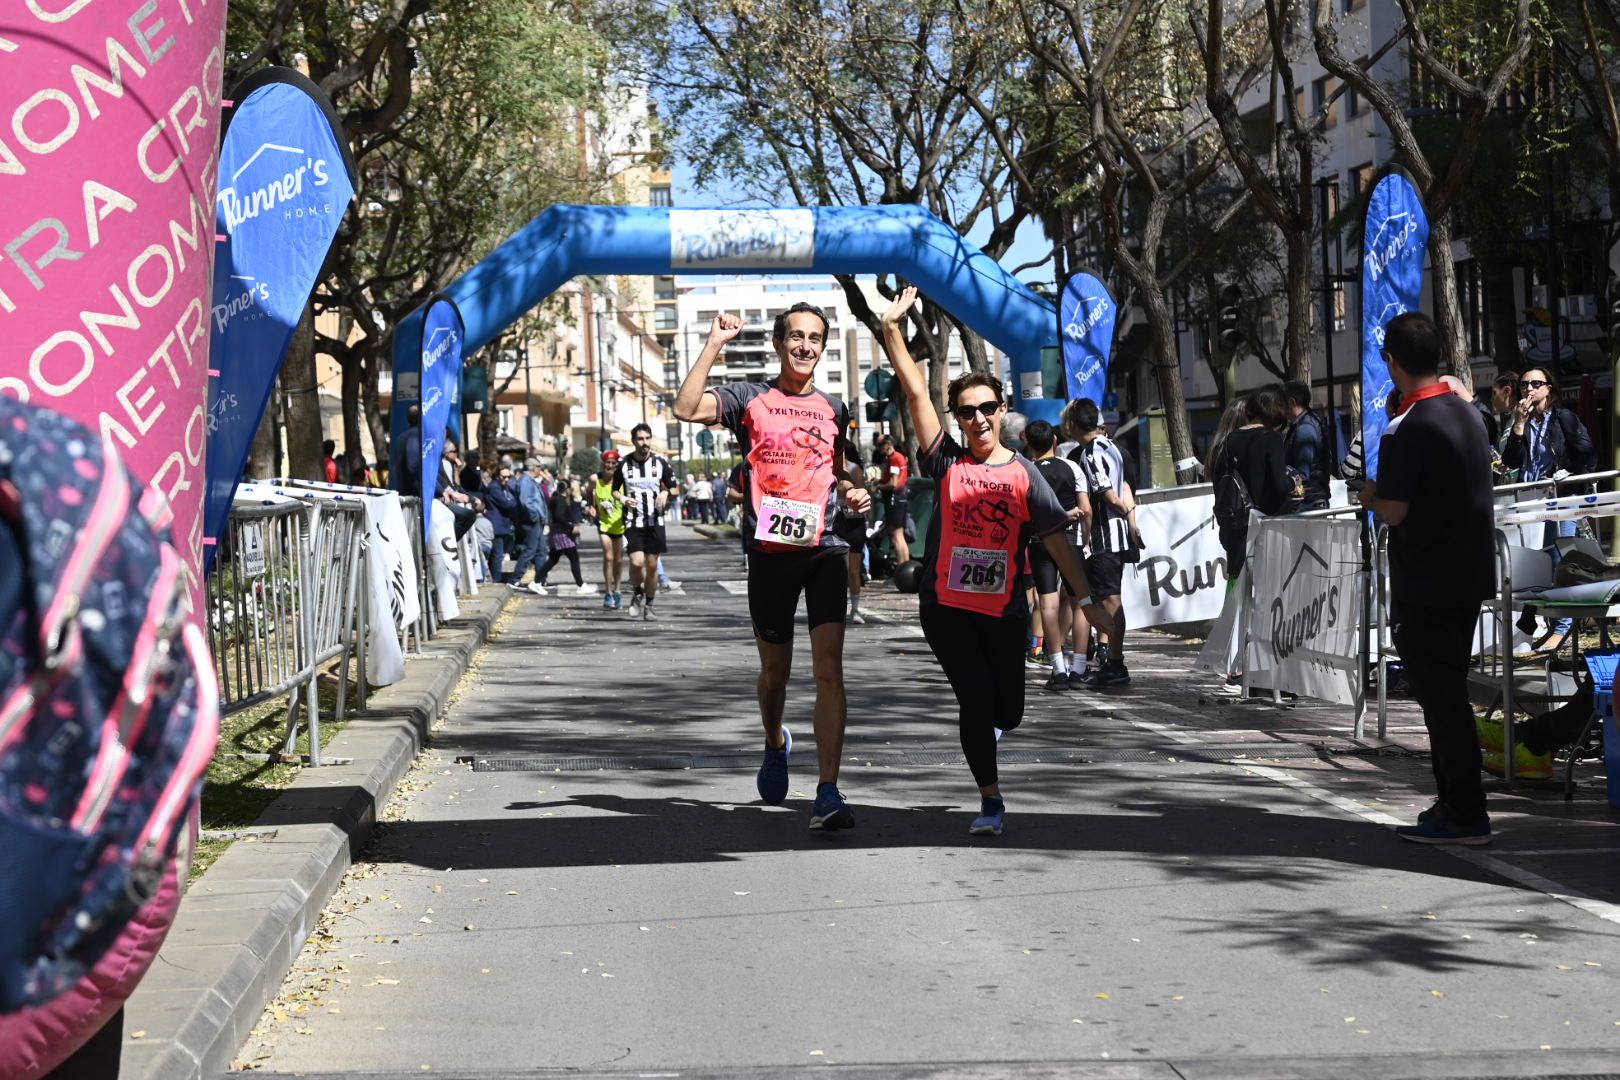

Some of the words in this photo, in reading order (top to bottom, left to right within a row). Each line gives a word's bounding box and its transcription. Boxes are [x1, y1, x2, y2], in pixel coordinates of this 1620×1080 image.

[217, 157, 330, 235] Runner's
[285, 203, 332, 220] HOME
[1364, 213, 1418, 282] Runner's
[1064, 298, 1109, 343] Runner's
[423, 329, 457, 372] Runner's
[768, 407, 787, 416] XXII
[788, 408, 824, 421] TROFEU
[762, 450, 779, 458] VOLTA
[978, 480, 1014, 493] TROFEU
[774, 499, 789, 507] 5K
[768, 513, 807, 539] 263
[963, 548, 978, 556] 5K
[960, 563, 995, 586] 264
[1271, 584, 1338, 665] Runner's
